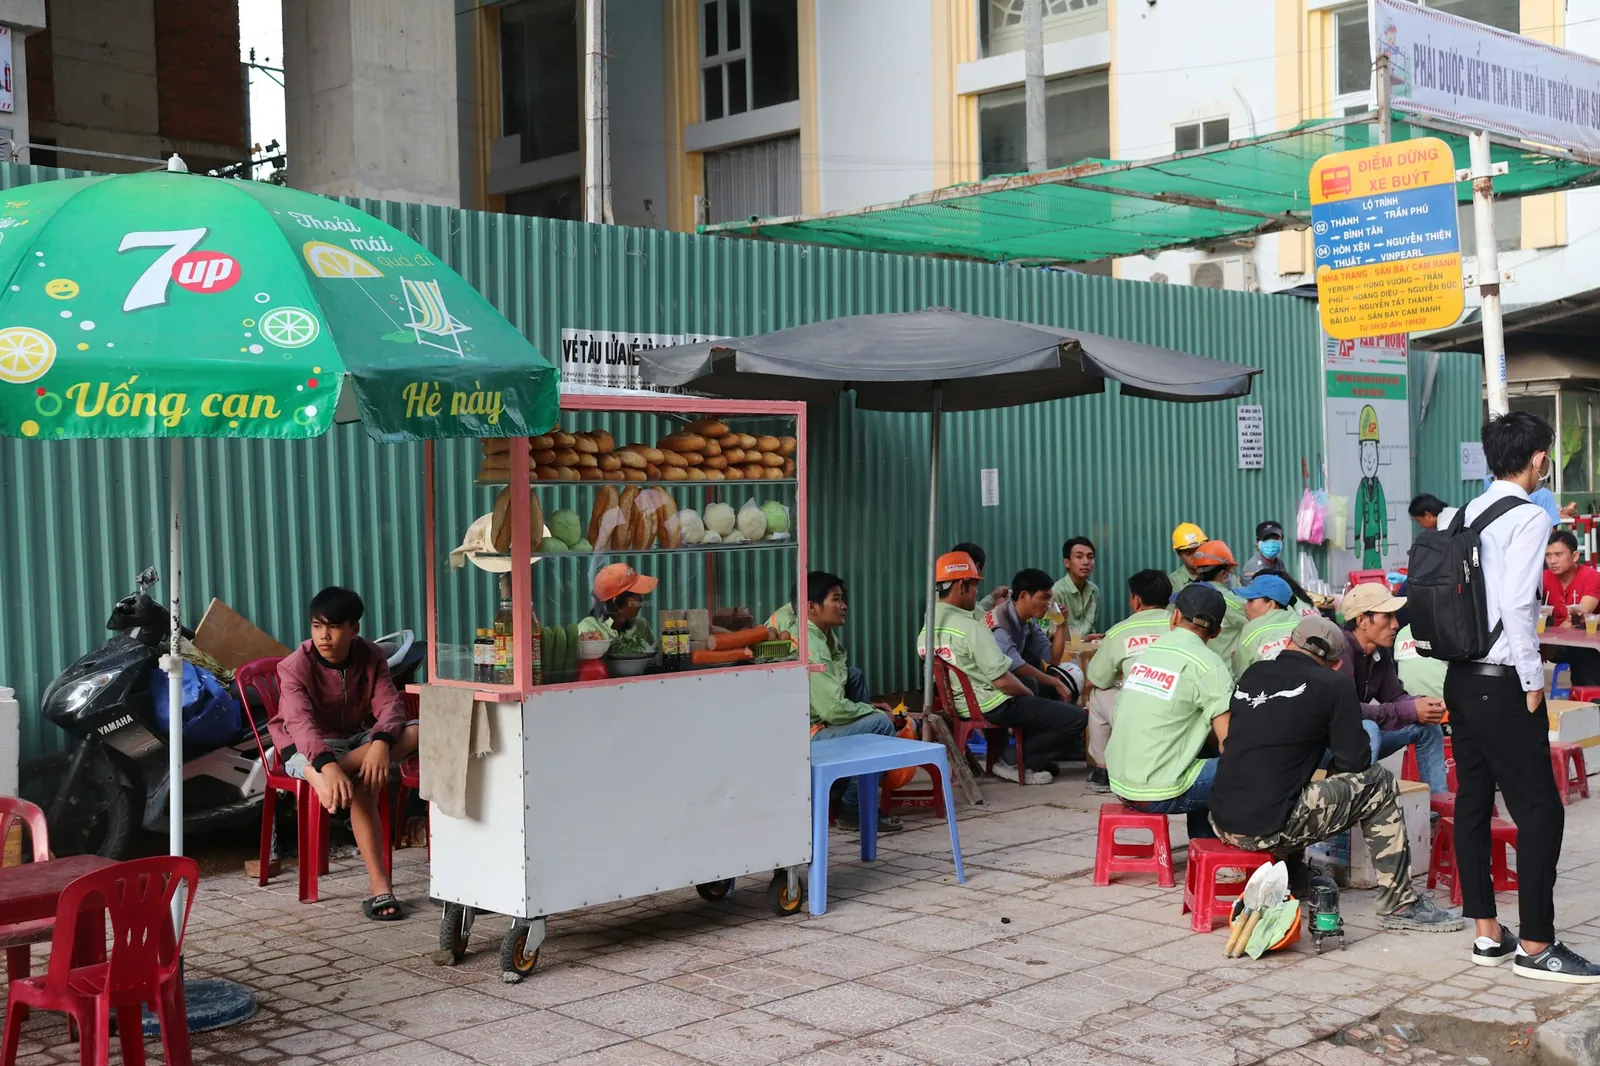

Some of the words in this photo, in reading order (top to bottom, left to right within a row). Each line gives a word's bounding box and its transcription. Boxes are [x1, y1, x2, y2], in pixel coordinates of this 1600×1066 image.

[1413, 34, 1436, 90] PHẢI
[1439, 46, 1465, 105] ĐƯỢC
[1467, 41, 1490, 103] KIỂM
[1491, 64, 1509, 108] TRA
[1511, 69, 1522, 111] AN
[1523, 65, 1546, 117] TOÀN
[1547, 74, 1574, 124] TRƯỚC
[1576, 87, 1589, 127] KHI
[1358, 152, 1393, 173] ĐIỂM
[1397, 148, 1439, 166] DỪNG
[1369, 178, 1388, 192] XE
[1392, 170, 1430, 189] BUÝT
[1330, 216, 1359, 228] THÀNH
[1410, 203, 1429, 216] PHÚ
[1362, 200, 1374, 211] LỘ
[1375, 197, 1399, 208] TRÌNH
[350, 235, 394, 253] mái
[1332, 243, 1351, 255] HÒN
[1352, 241, 1370, 253] XỆN
[1386, 234, 1423, 248] NGUYỄN
[1425, 230, 1452, 242] THIỆN
[1343, 228, 1364, 240] BÌNH
[1365, 225, 1383, 236] TÂN
[1334, 256, 1362, 269] THUẬT
[1381, 249, 1424, 262] VINPEARL
[1322, 275, 1339, 285] NHA
[1340, 271, 1368, 282] TRANG
[1393, 264, 1410, 274] BAY
[1412, 261, 1431, 272] CAM
[1432, 258, 1456, 270] RANH
[1327, 284, 1354, 295] YERSIN
[1419, 305, 1441, 315] RANH
[563, 333, 579, 363] VÉ
[580, 334, 602, 365] TÀU
[605, 334, 627, 365] LỬA
[66, 374, 189, 427] Uống
[200, 399, 281, 428] cạn
[402, 381, 442, 418] Hè
[450, 386, 504, 425] này
[97, 714, 134, 736] YAMAHA
